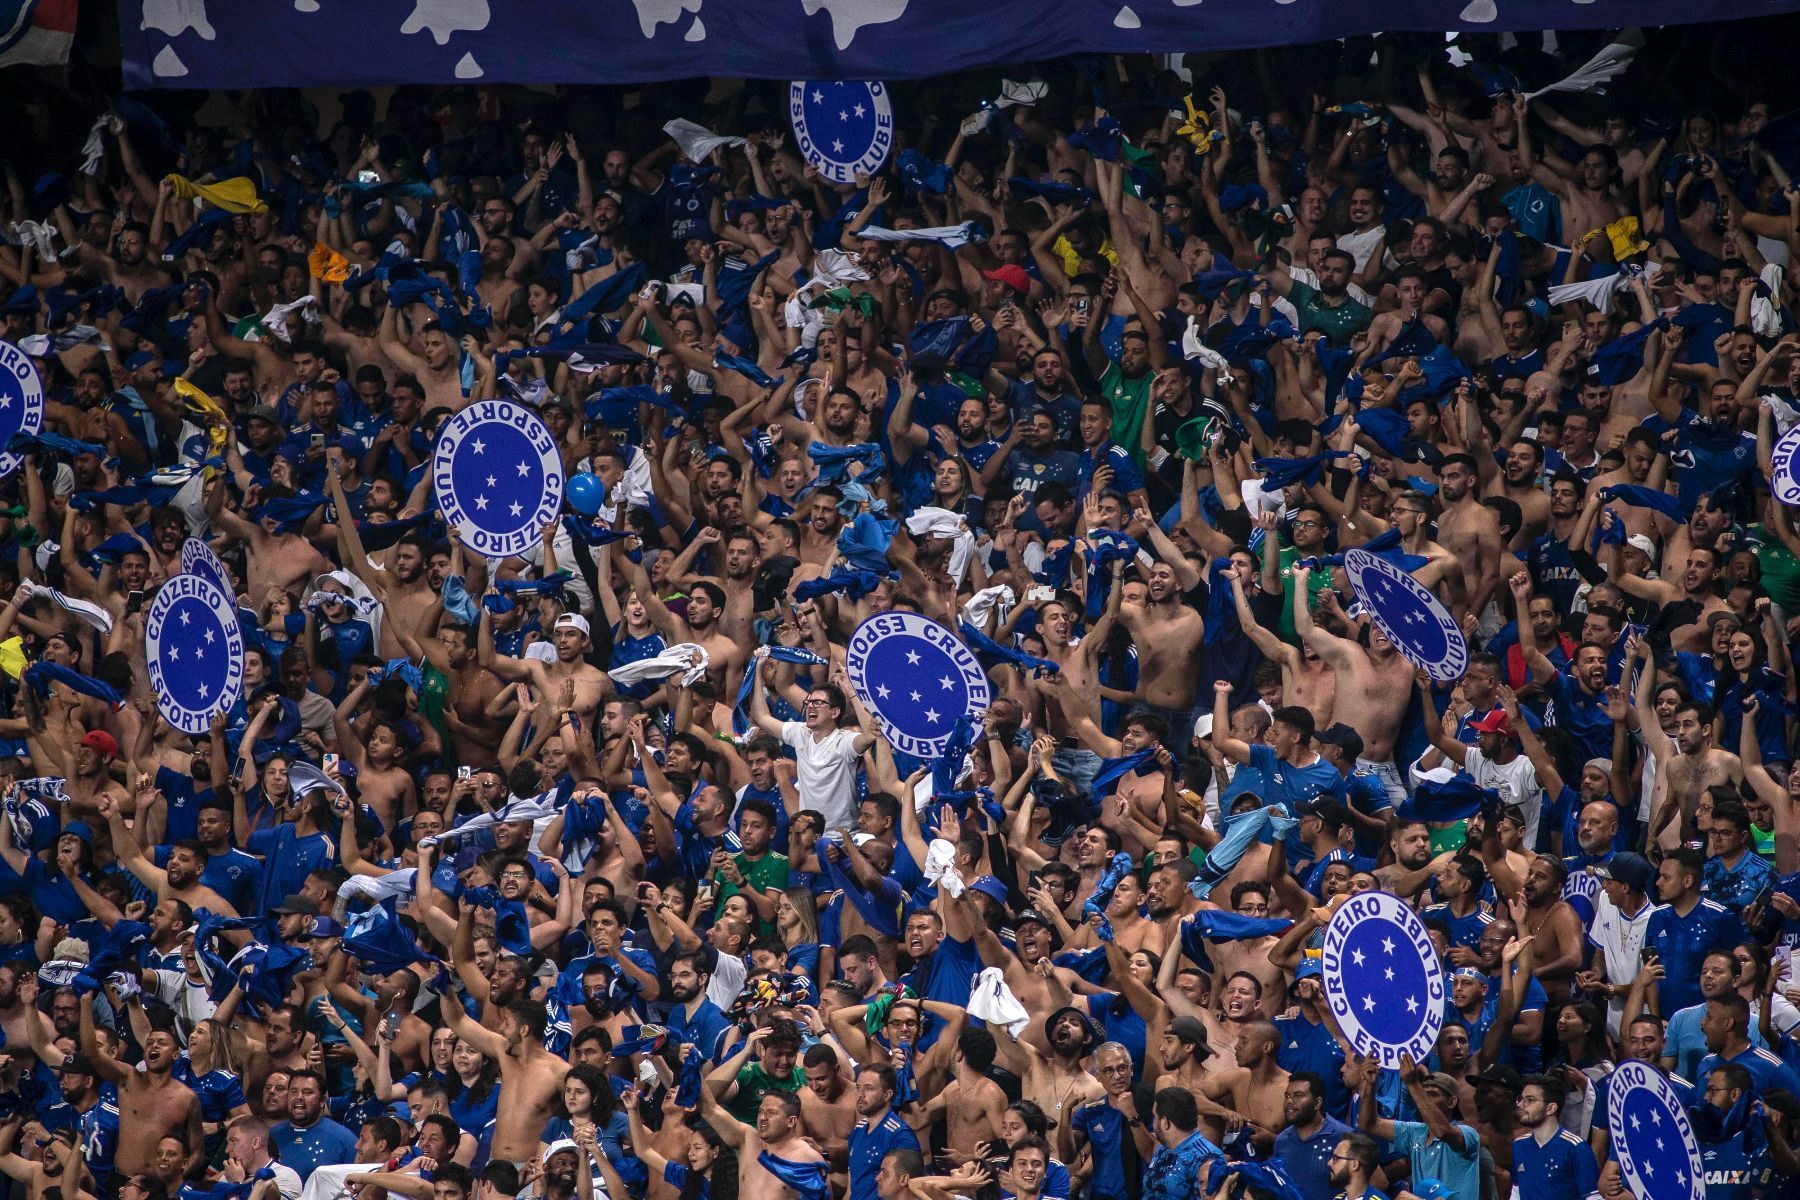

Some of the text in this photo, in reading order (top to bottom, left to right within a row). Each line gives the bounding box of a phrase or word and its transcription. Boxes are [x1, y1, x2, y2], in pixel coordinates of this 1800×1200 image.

[792, 84, 846, 181] ESPORTE
[452, 402, 554, 456] ESPORTE
[436, 436, 466, 528] CLUBE
[473, 472, 560, 553] CRUZEIRO
[183, 540, 222, 578] RUZEIRO
[1347, 550, 1432, 604] CRUZEIRO
[148, 577, 221, 640] CRUZEIRO
[1440, 617, 1465, 678] CLUBE
[219, 619, 242, 712] CLUBE
[848, 615, 907, 702] ESPORTE
[1325, 897, 1381, 1017] CRUZEIRO
[1394, 904, 1443, 1000] CLUBE
[1611, 1066, 1646, 1176] CRUZEIRO
[1657, 1077, 1703, 1179] CLUBE
